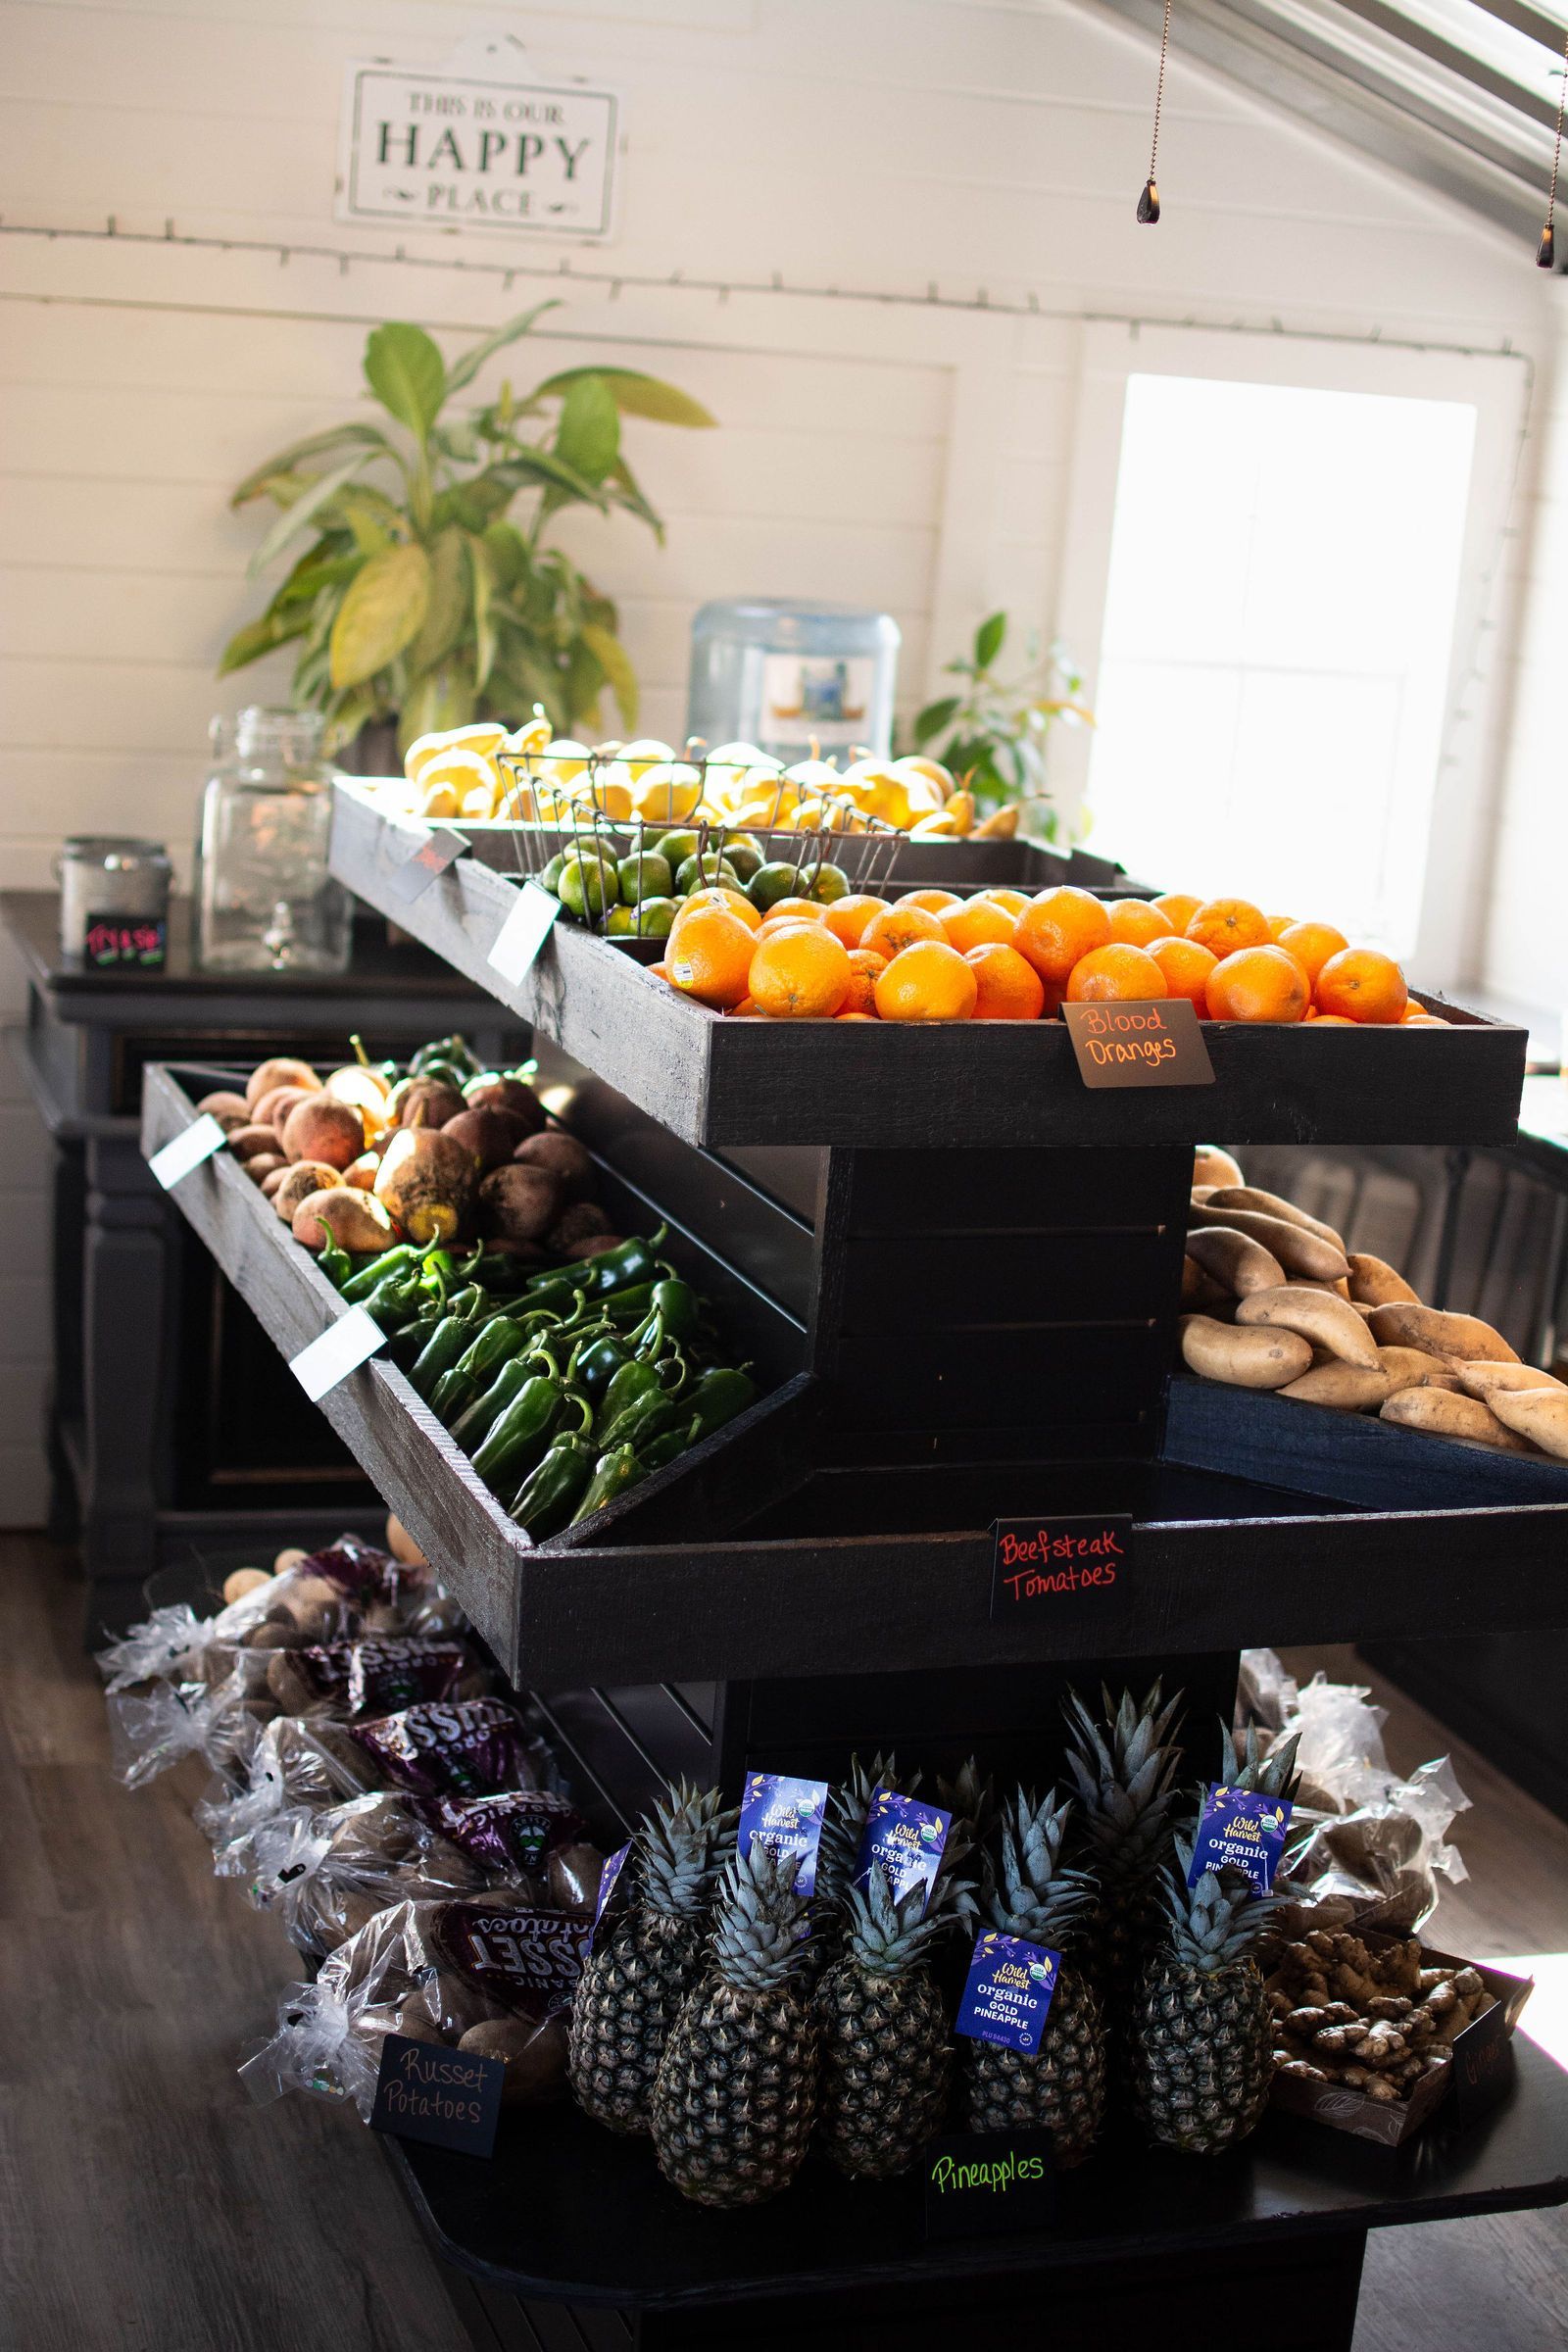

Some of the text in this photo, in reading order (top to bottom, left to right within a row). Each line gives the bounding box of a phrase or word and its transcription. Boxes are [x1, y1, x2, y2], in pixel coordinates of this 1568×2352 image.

[409, 91, 564, 125] THIS IS OUR
[376, 120, 591, 180] HAPPY
[427, 183, 532, 217] PLACE
[1080, 1007, 1167, 1034] Blood
[999, 1530, 1124, 1566] Beefsteak
[1004, 1562, 1116, 1601] Tomatoes
[761, 1813, 800, 1830] Harvest
[771, 1803, 796, 1819] Wild
[895, 1823, 919, 1840] Wild
[1223, 1824, 1262, 1842] Harvest
[1233, 1816, 1258, 1832] Wild
[749, 1829, 808, 1847] organic
[1208, 1838, 1268, 1860] organic
[871, 1843, 927, 1871] orgaic
[1220, 1855, 1249, 1868] GOLD
[881, 1862, 906, 1879] GOLD
[992, 1970, 1031, 1990] Harvest
[1002, 1962, 1028, 1980] Wild
[977, 1984, 1038, 2009] organic
[973, 2006, 1029, 2030] PINEAPPLE
[989, 2001, 1018, 2016] GOLD
[400, 2047, 488, 2093] Russet
[383, 2080, 481, 2123] Potatoes
[932, 2151, 1044, 2193] Pineapples
